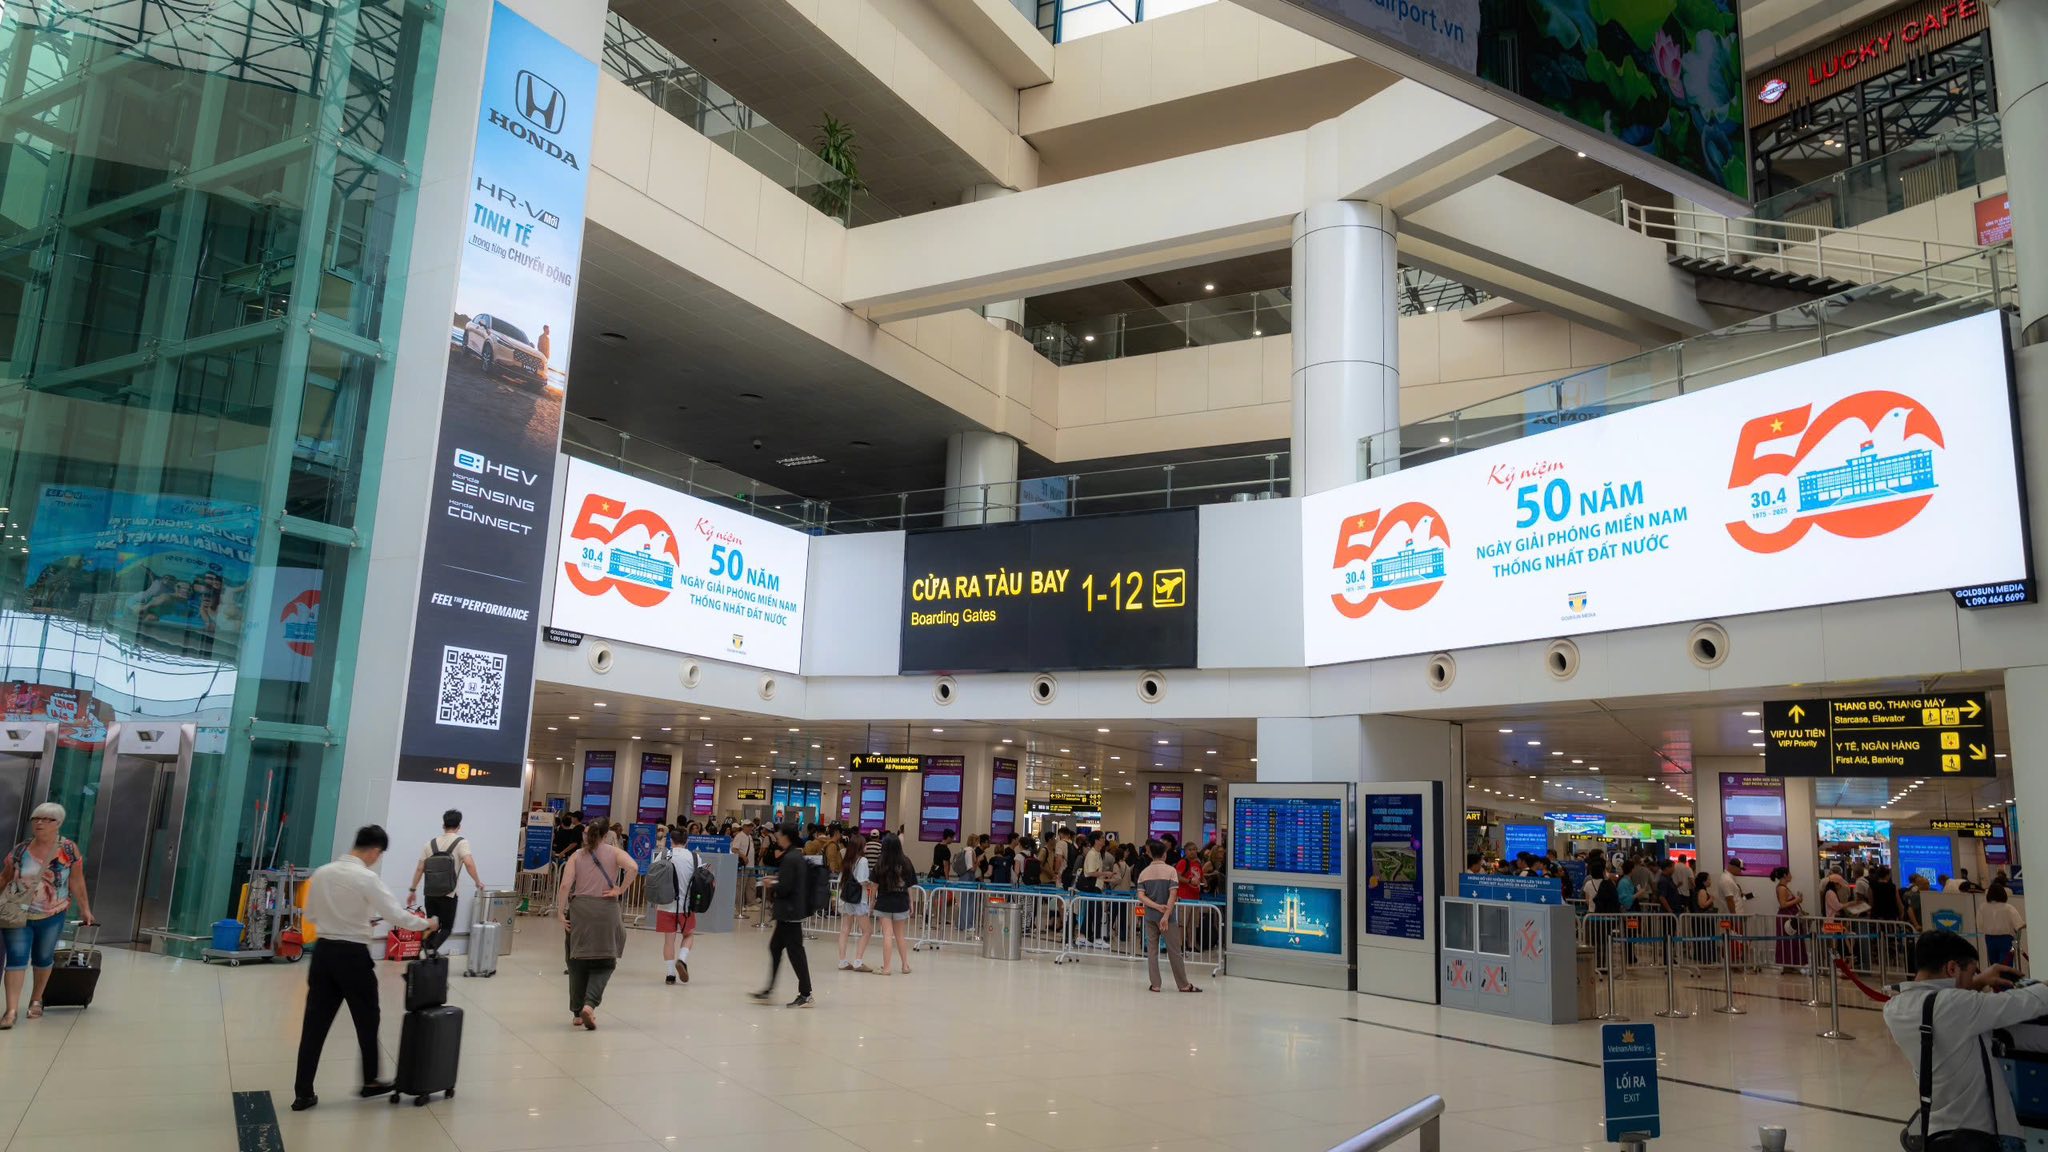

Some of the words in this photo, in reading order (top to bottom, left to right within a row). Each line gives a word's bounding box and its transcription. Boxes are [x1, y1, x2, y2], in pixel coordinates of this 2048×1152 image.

[1808, 32, 1894, 86] LUCKY
[488, 107, 580, 171] HONDA
[476, 176, 543, 221] HR-V
[474, 203, 511, 239] TINH
[508, 247, 545, 273] CHUYỂN
[545, 266, 572, 287] ĐỘNG
[452, 472, 480, 484] Honda
[451, 480, 535, 512] SENSING
[1516, 478, 1572, 529] 50
[1579, 480, 1644, 517] NĂM
[1751, 487, 1787, 508] 30.4
[448, 506, 532, 535] CONNECT
[1476, 538, 1512, 560] NGÀY
[1515, 531, 1545, 553] GIẢI
[1547, 522, 1601, 549] PHÓNG
[1604, 511, 1646, 541] MIỀN
[1648, 506, 1689, 531] NAM
[582, 547, 603, 562] 30.4
[1492, 553, 1543, 579] THỐNG
[1545, 545, 1585, 570] NHẤT
[1588, 539, 1617, 563] ĐẤT
[1621, 532, 1670, 558] NƯỚC
[709, 544, 744, 581] 50
[746, 567, 780, 592] NĂM
[1345, 569, 1366, 584] 30.4
[680, 573, 705, 590] NGÀY
[706, 581, 725, 595] GIẢI
[726, 584, 756, 603] PHÓNG
[757, 593, 778, 608] MIỀN
[778, 599, 797, 613] NAM
[912, 573, 951, 602] CỬA
[955, 575, 981, 599] RA
[985, 568, 1023, 596] TÀU
[1030, 569, 1070, 594] BAY
[1081, 571, 1143, 612] 1-12
[1955, 587, 1994, 598] GOLDSUN
[1996, 583, 2025, 593] MEDIA
[431, 592, 453, 607] FEEL
[461, 598, 530, 621] PERFORMANCE
[690, 592, 721, 611] THỐNG
[722, 599, 747, 616] NHẤT
[747, 605, 764, 621] ĐẤT
[764, 610, 788, 626] NƯỚC
[1972, 597, 1987, 606] 090
[1988, 595, 2003, 604] 464
[2005, 592, 2025, 602] 6699
[911, 611, 960, 627] Boarding
[963, 608, 997, 623] Gates
[1834, 701, 1867, 712] THANG
[1887, 699, 1922, 709] THANG
[1924, 697, 1946, 708] MÁY
[1872, 714, 1905, 723] Elevator
[1770, 730, 1788, 739] VIP/
[1804, 728, 1826, 739] TIÊN
[1794, 739, 1818, 748] Priority
[1836, 742, 1843, 751] Y
[1861, 740, 1890, 751] NGÂN
[1891, 740, 1920, 751] HÀNG
[1836, 756, 1854, 765] First
[1854, 756, 1870, 765] Aid,
[1871, 756, 1904, 766] Banking
[1608, 1045, 1629, 1053] Vietnam
[1616, 1071, 1631, 1089] LỐI
[1633, 1075, 1646, 1088] RA
[1623, 1093, 1640, 1103] EXIT
